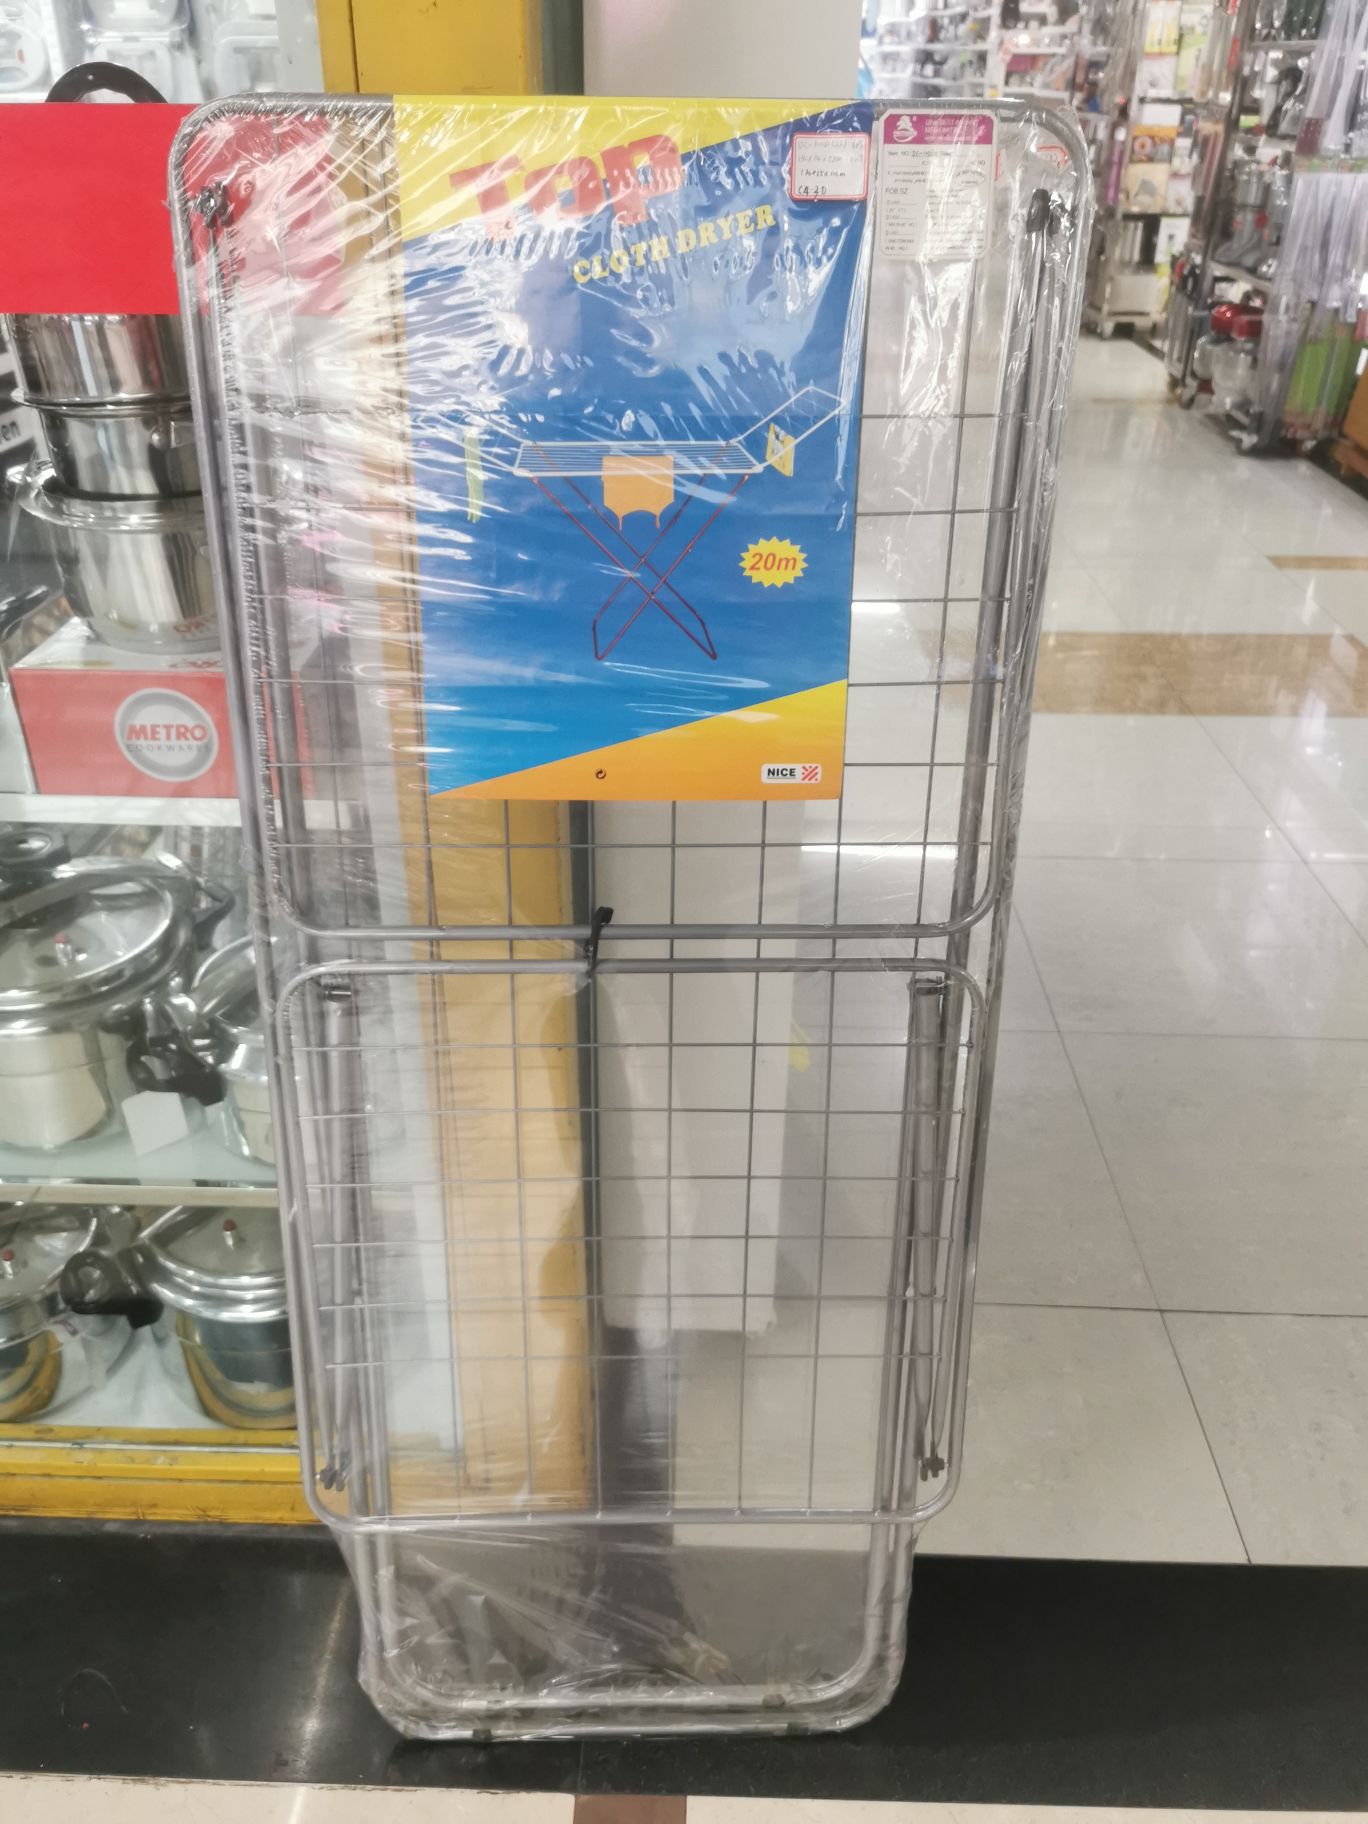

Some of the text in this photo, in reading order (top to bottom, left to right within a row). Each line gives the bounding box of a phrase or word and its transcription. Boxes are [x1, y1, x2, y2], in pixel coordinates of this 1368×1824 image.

[572, 204, 776, 284] CLOTH DRYER
[749, 552, 798, 572] 20m
[126, 724, 208, 742] METRO
[767, 767, 797, 777] NICE
